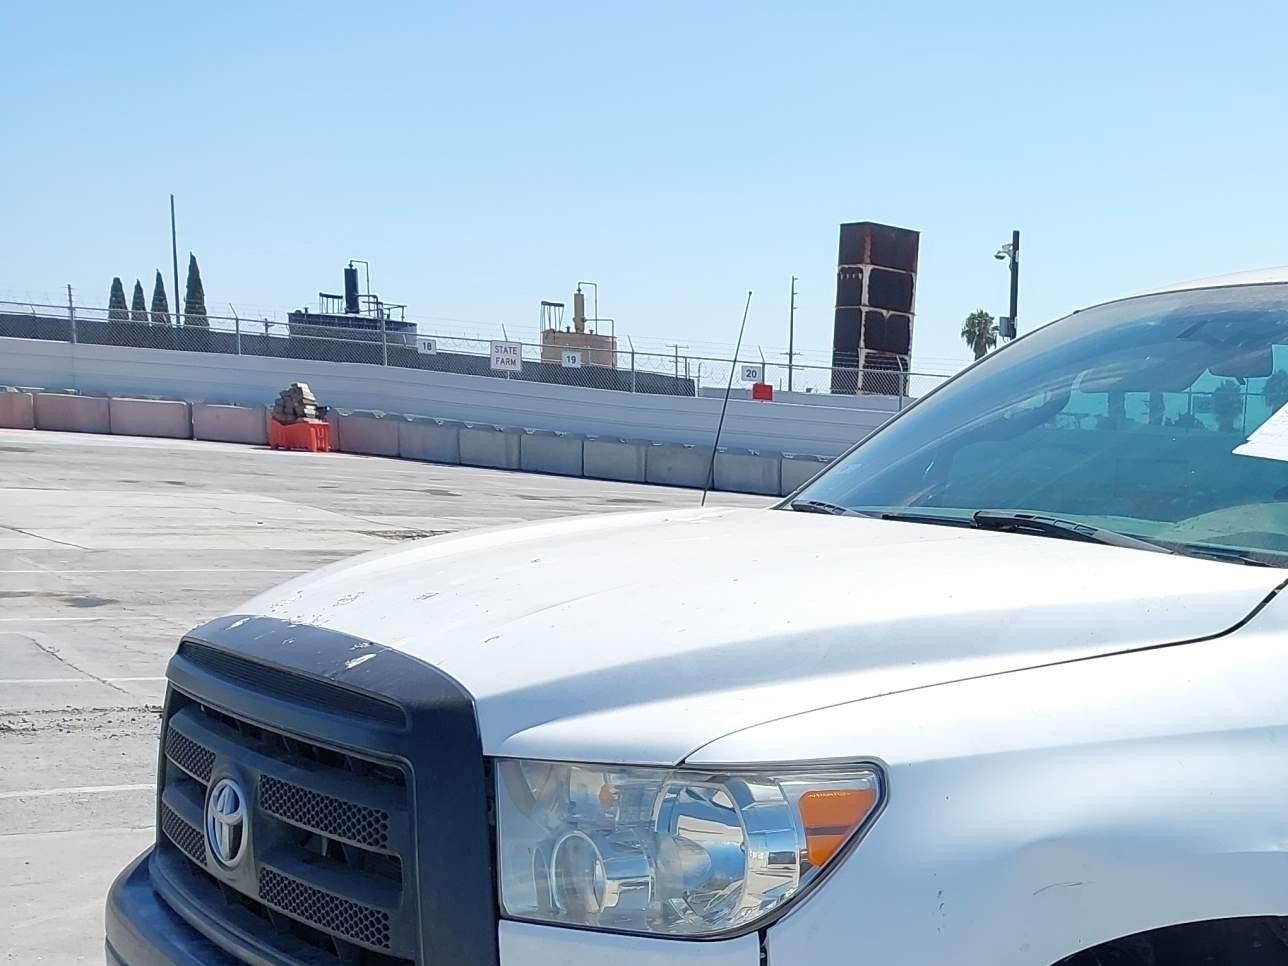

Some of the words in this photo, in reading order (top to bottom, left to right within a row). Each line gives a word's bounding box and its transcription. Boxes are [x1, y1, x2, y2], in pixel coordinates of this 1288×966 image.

[494, 345, 518, 355] STATE
[495, 357, 517, 366] FARM
[566, 355, 577, 364] 19
[746, 368, 758, 379] 20
